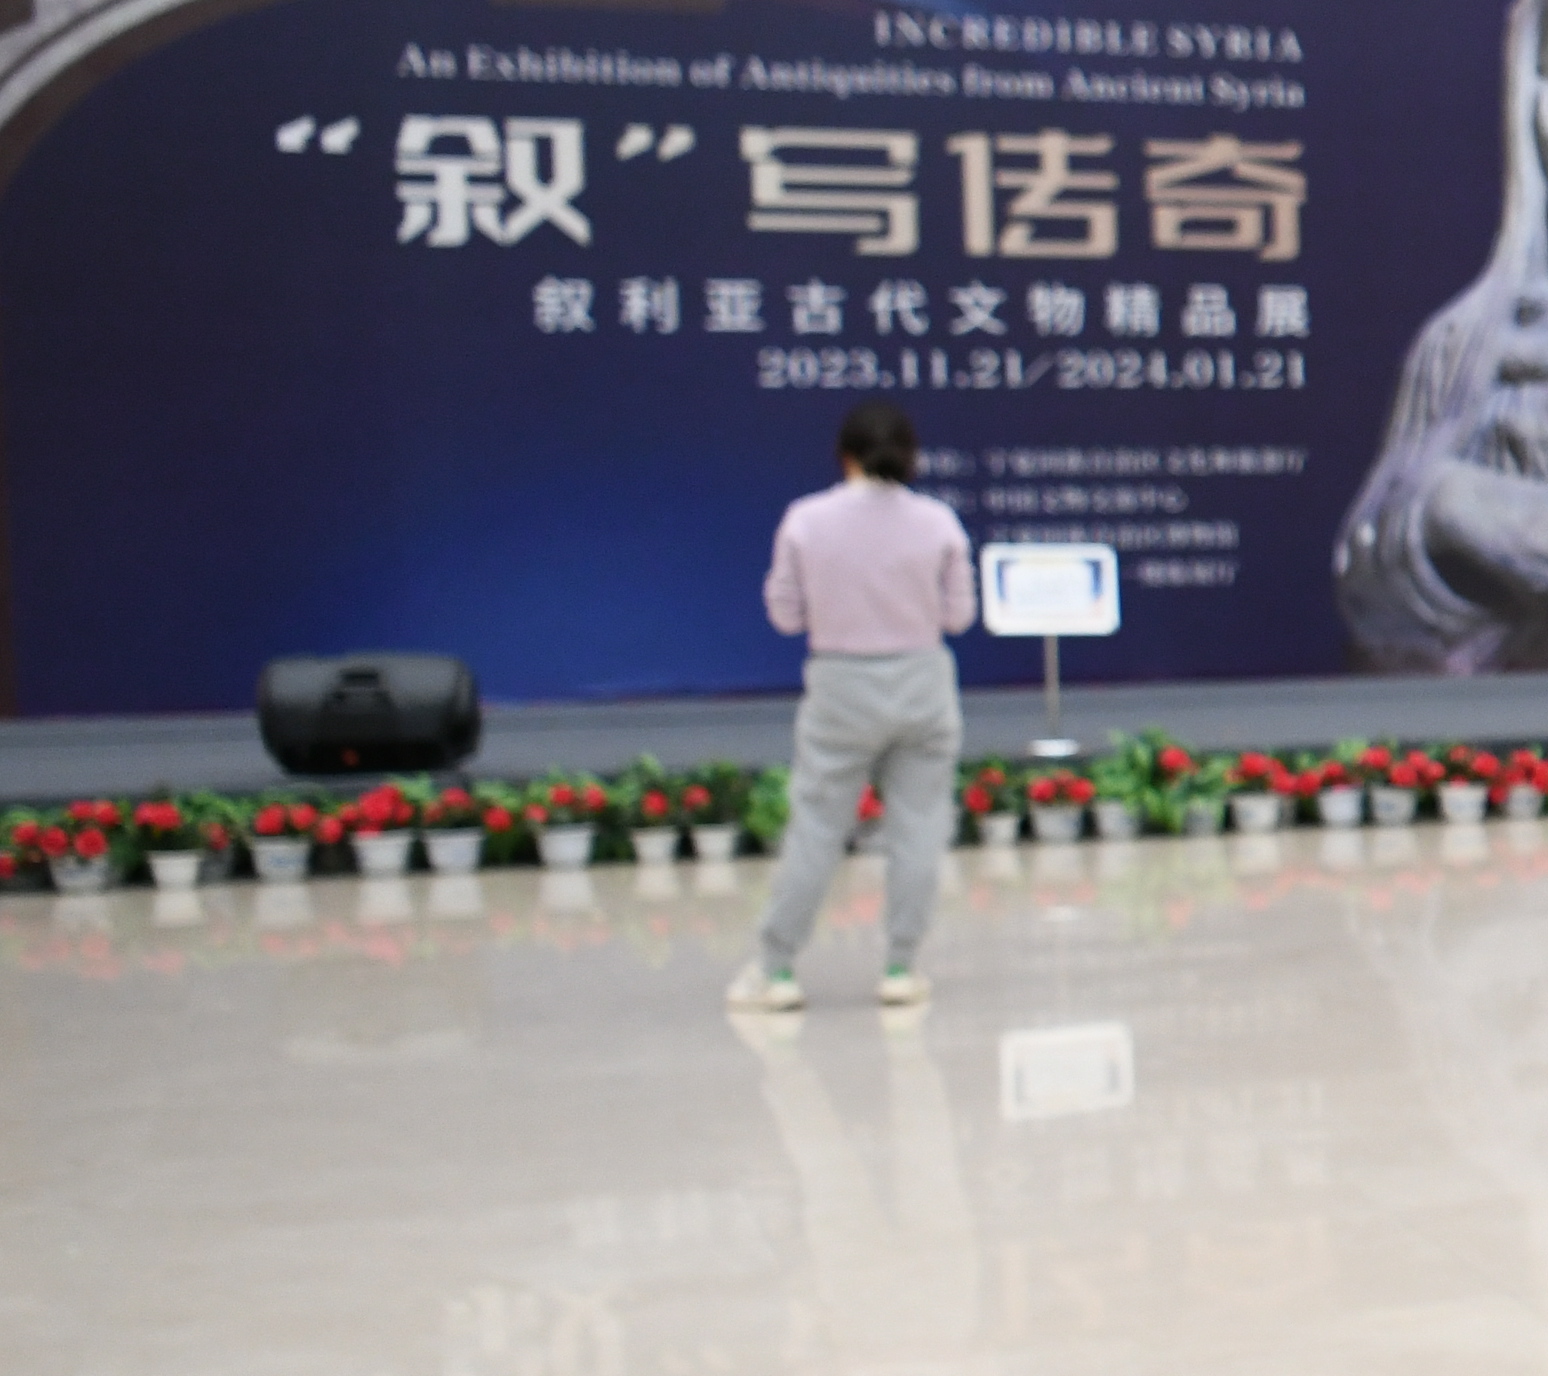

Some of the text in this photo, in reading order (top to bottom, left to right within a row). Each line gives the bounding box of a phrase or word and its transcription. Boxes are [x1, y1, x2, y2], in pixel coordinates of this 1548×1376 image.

[874, 10, 1304, 63] INCREDIBLE SYRIA
[398, 41, 1306, 113] An Exhibition of Antiquities from Ancient Syria
[533, 274, 1312, 339] 叙利亚古代文物精品展
